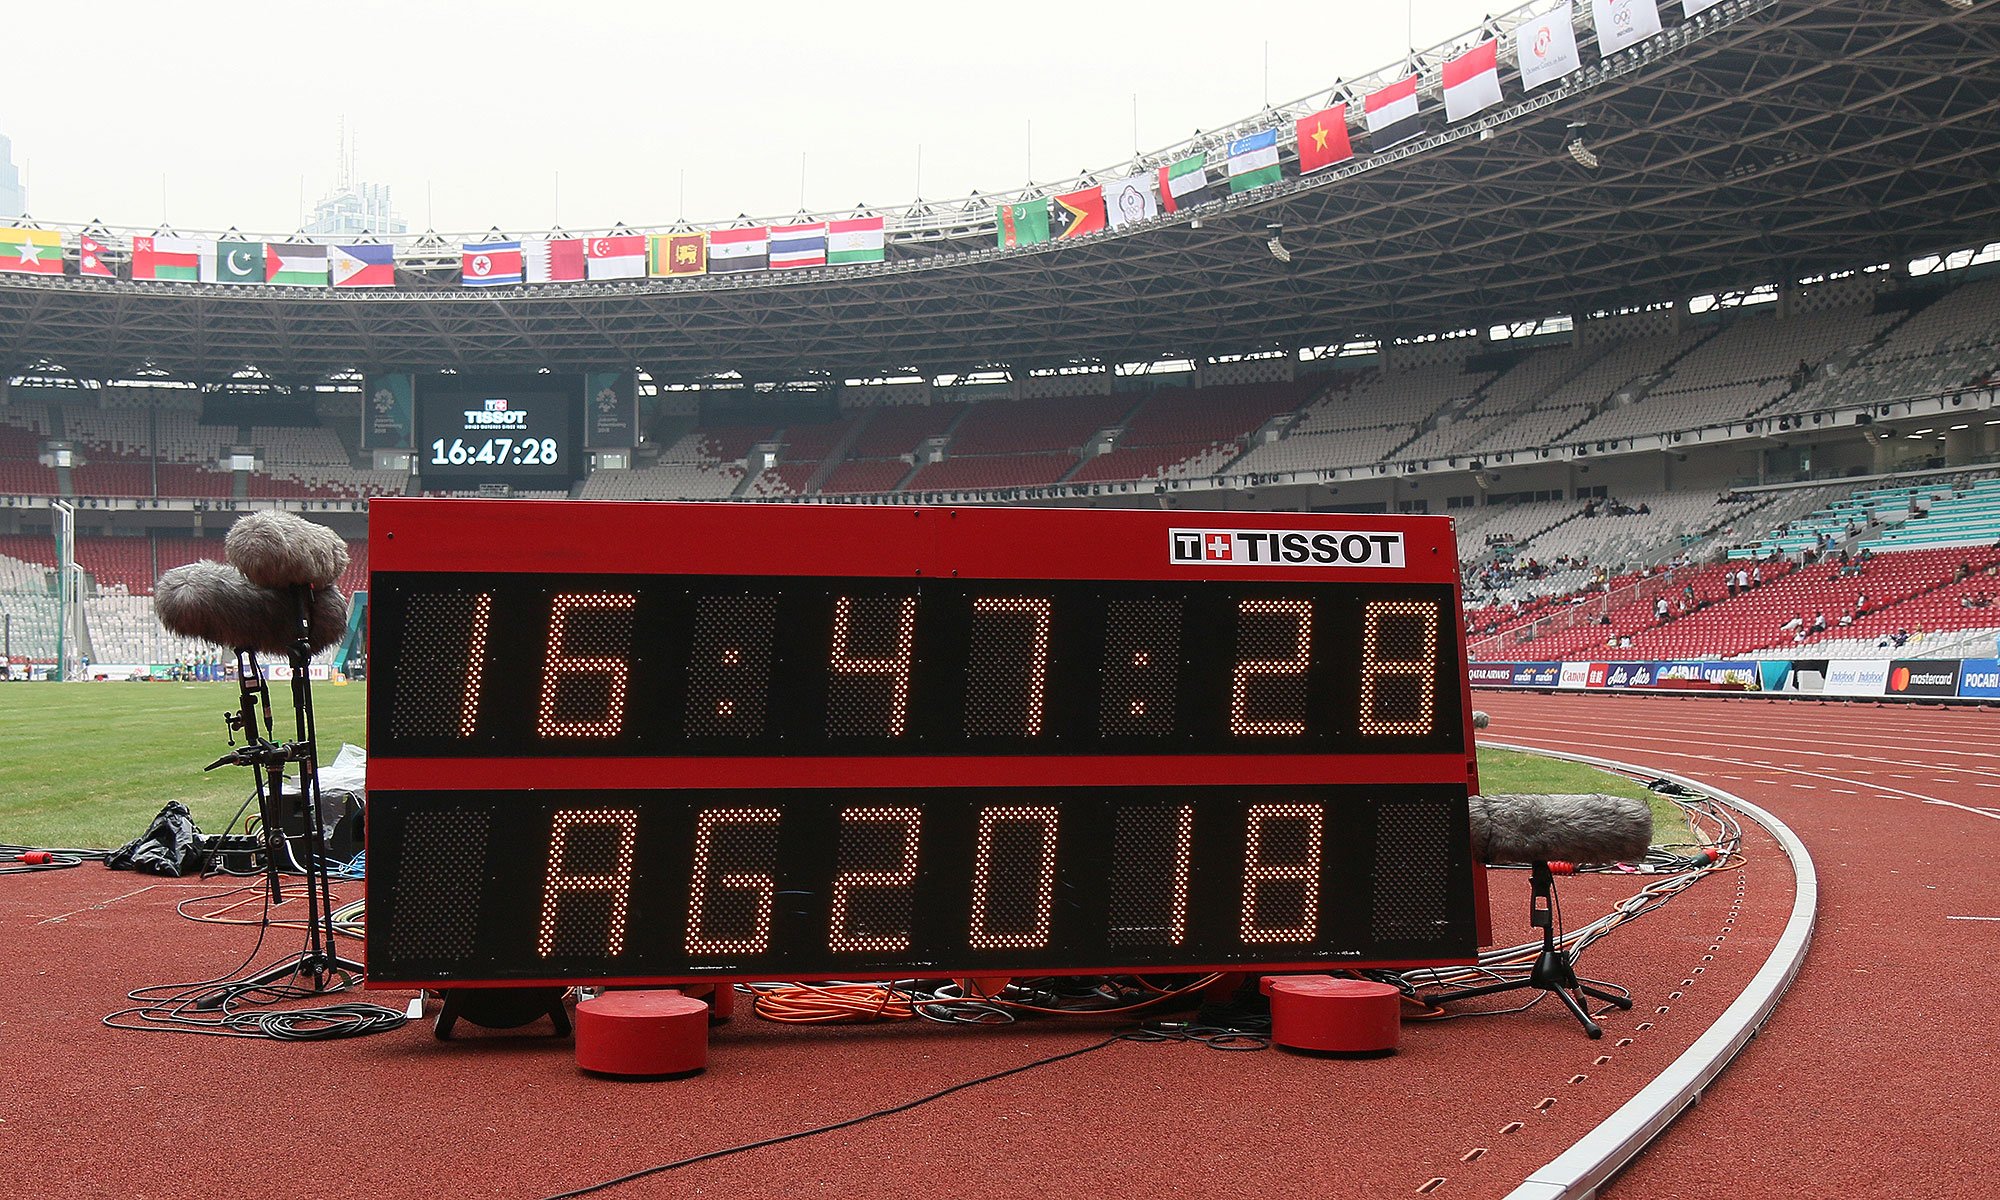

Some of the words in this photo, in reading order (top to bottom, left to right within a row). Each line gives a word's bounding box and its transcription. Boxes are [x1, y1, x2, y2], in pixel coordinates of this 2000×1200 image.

[464, 410, 527, 424] TISSOT
[431, 438, 558, 465] 16:47:28
[1237, 533, 1399, 564] TISSOT
[1562, 670, 1585, 682] Canon
[1909, 672, 1953, 685] mastercard
[1964, 673, 1999, 687] POCARI
[537, 804, 1324, 956] AG2018
